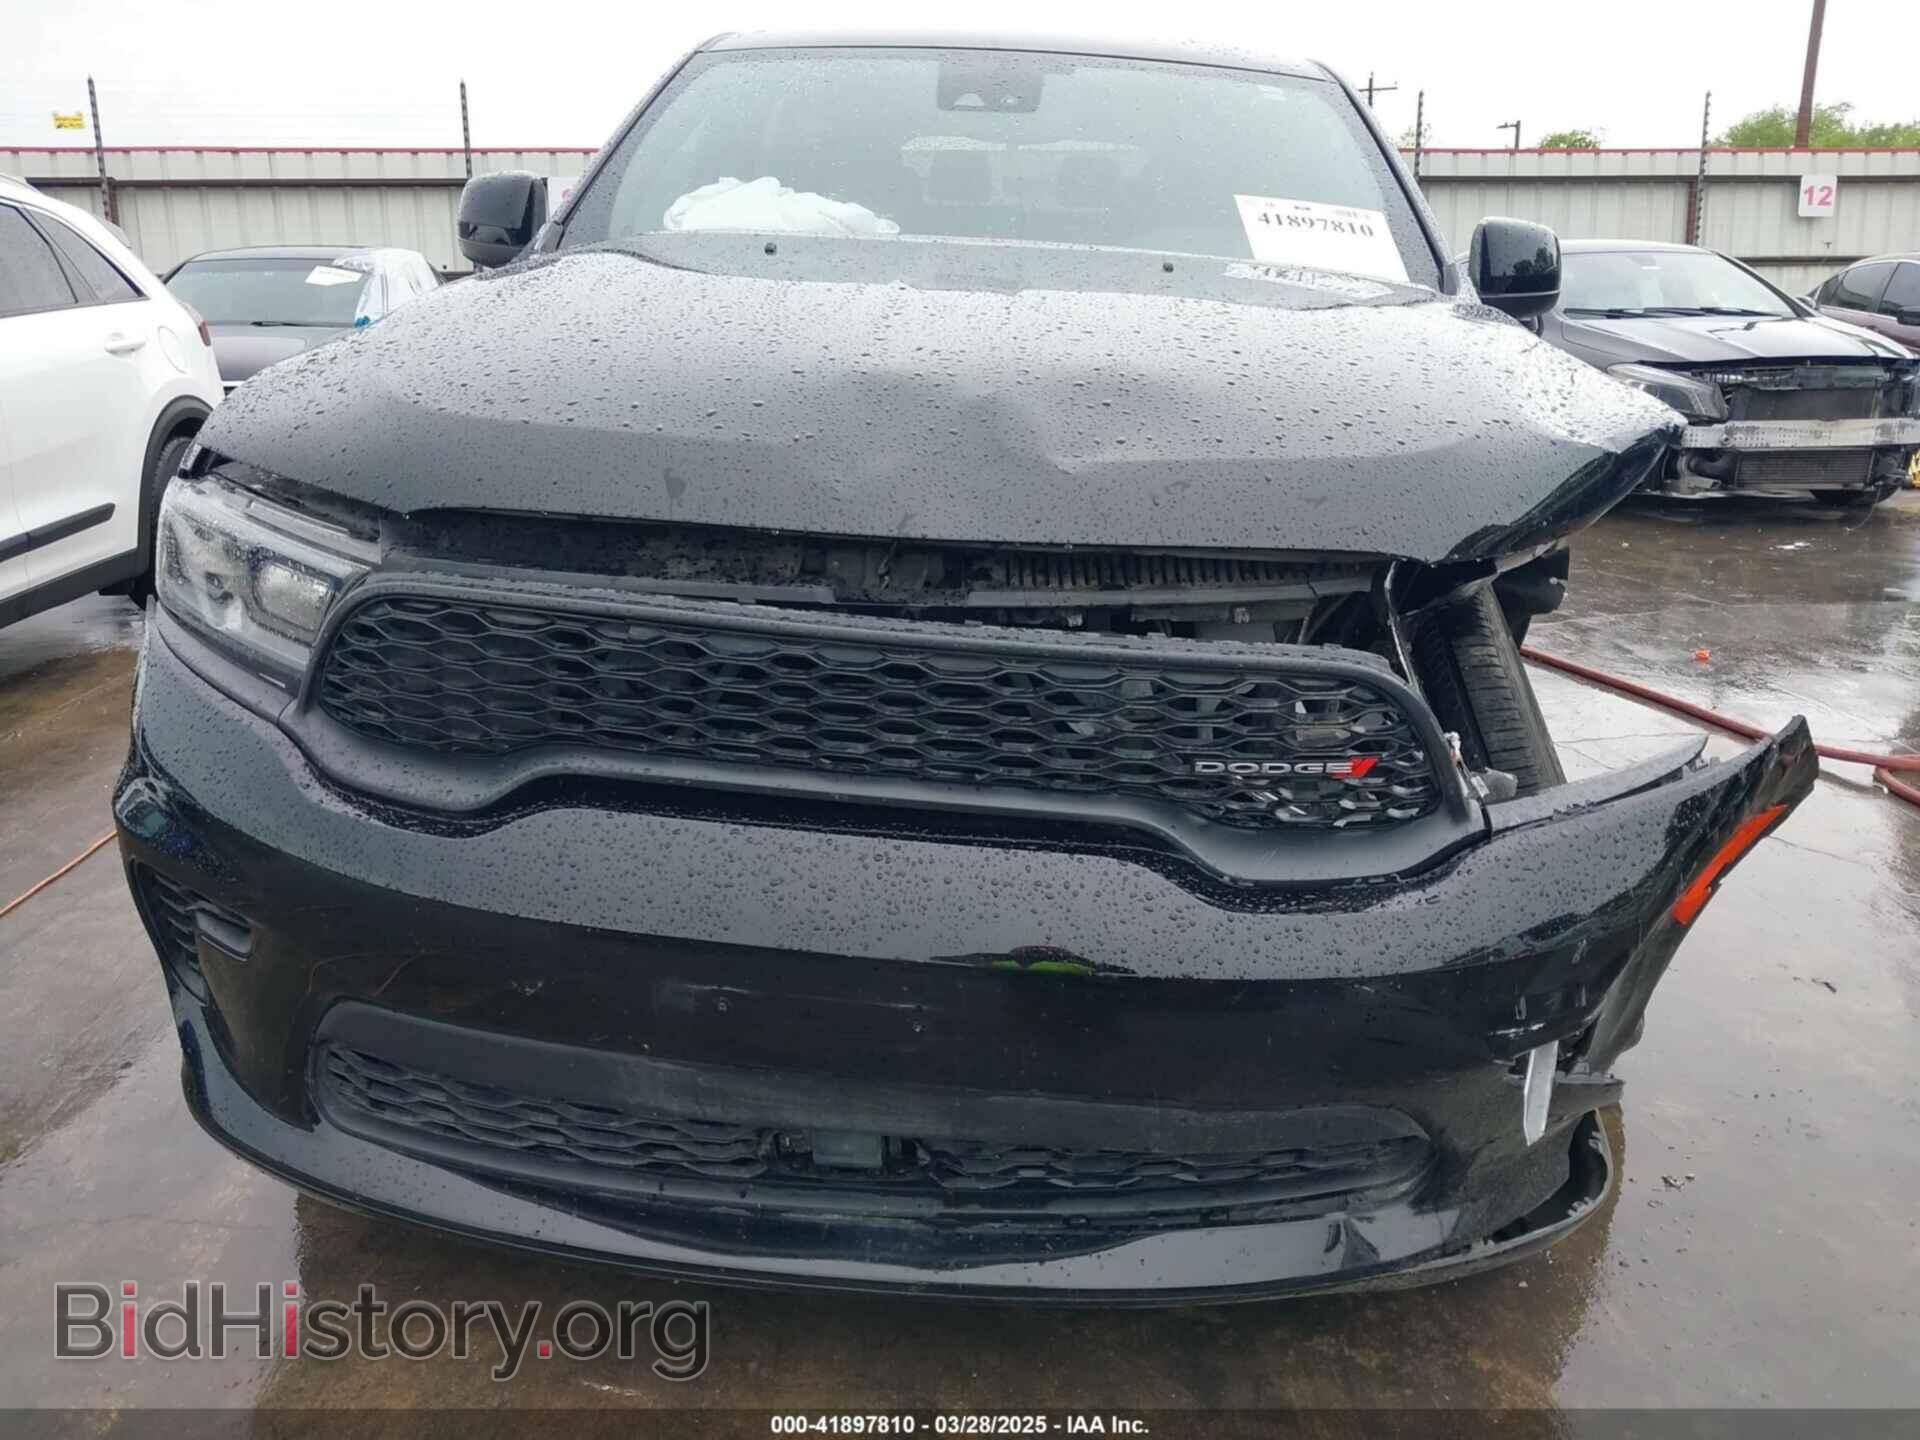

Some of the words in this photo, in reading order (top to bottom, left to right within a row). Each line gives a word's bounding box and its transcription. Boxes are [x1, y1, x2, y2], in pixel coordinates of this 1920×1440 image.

[1804, 185, 1833, 206] 12
[1257, 211, 1374, 238] 41897810
[1195, 761, 1353, 774] DODGE
